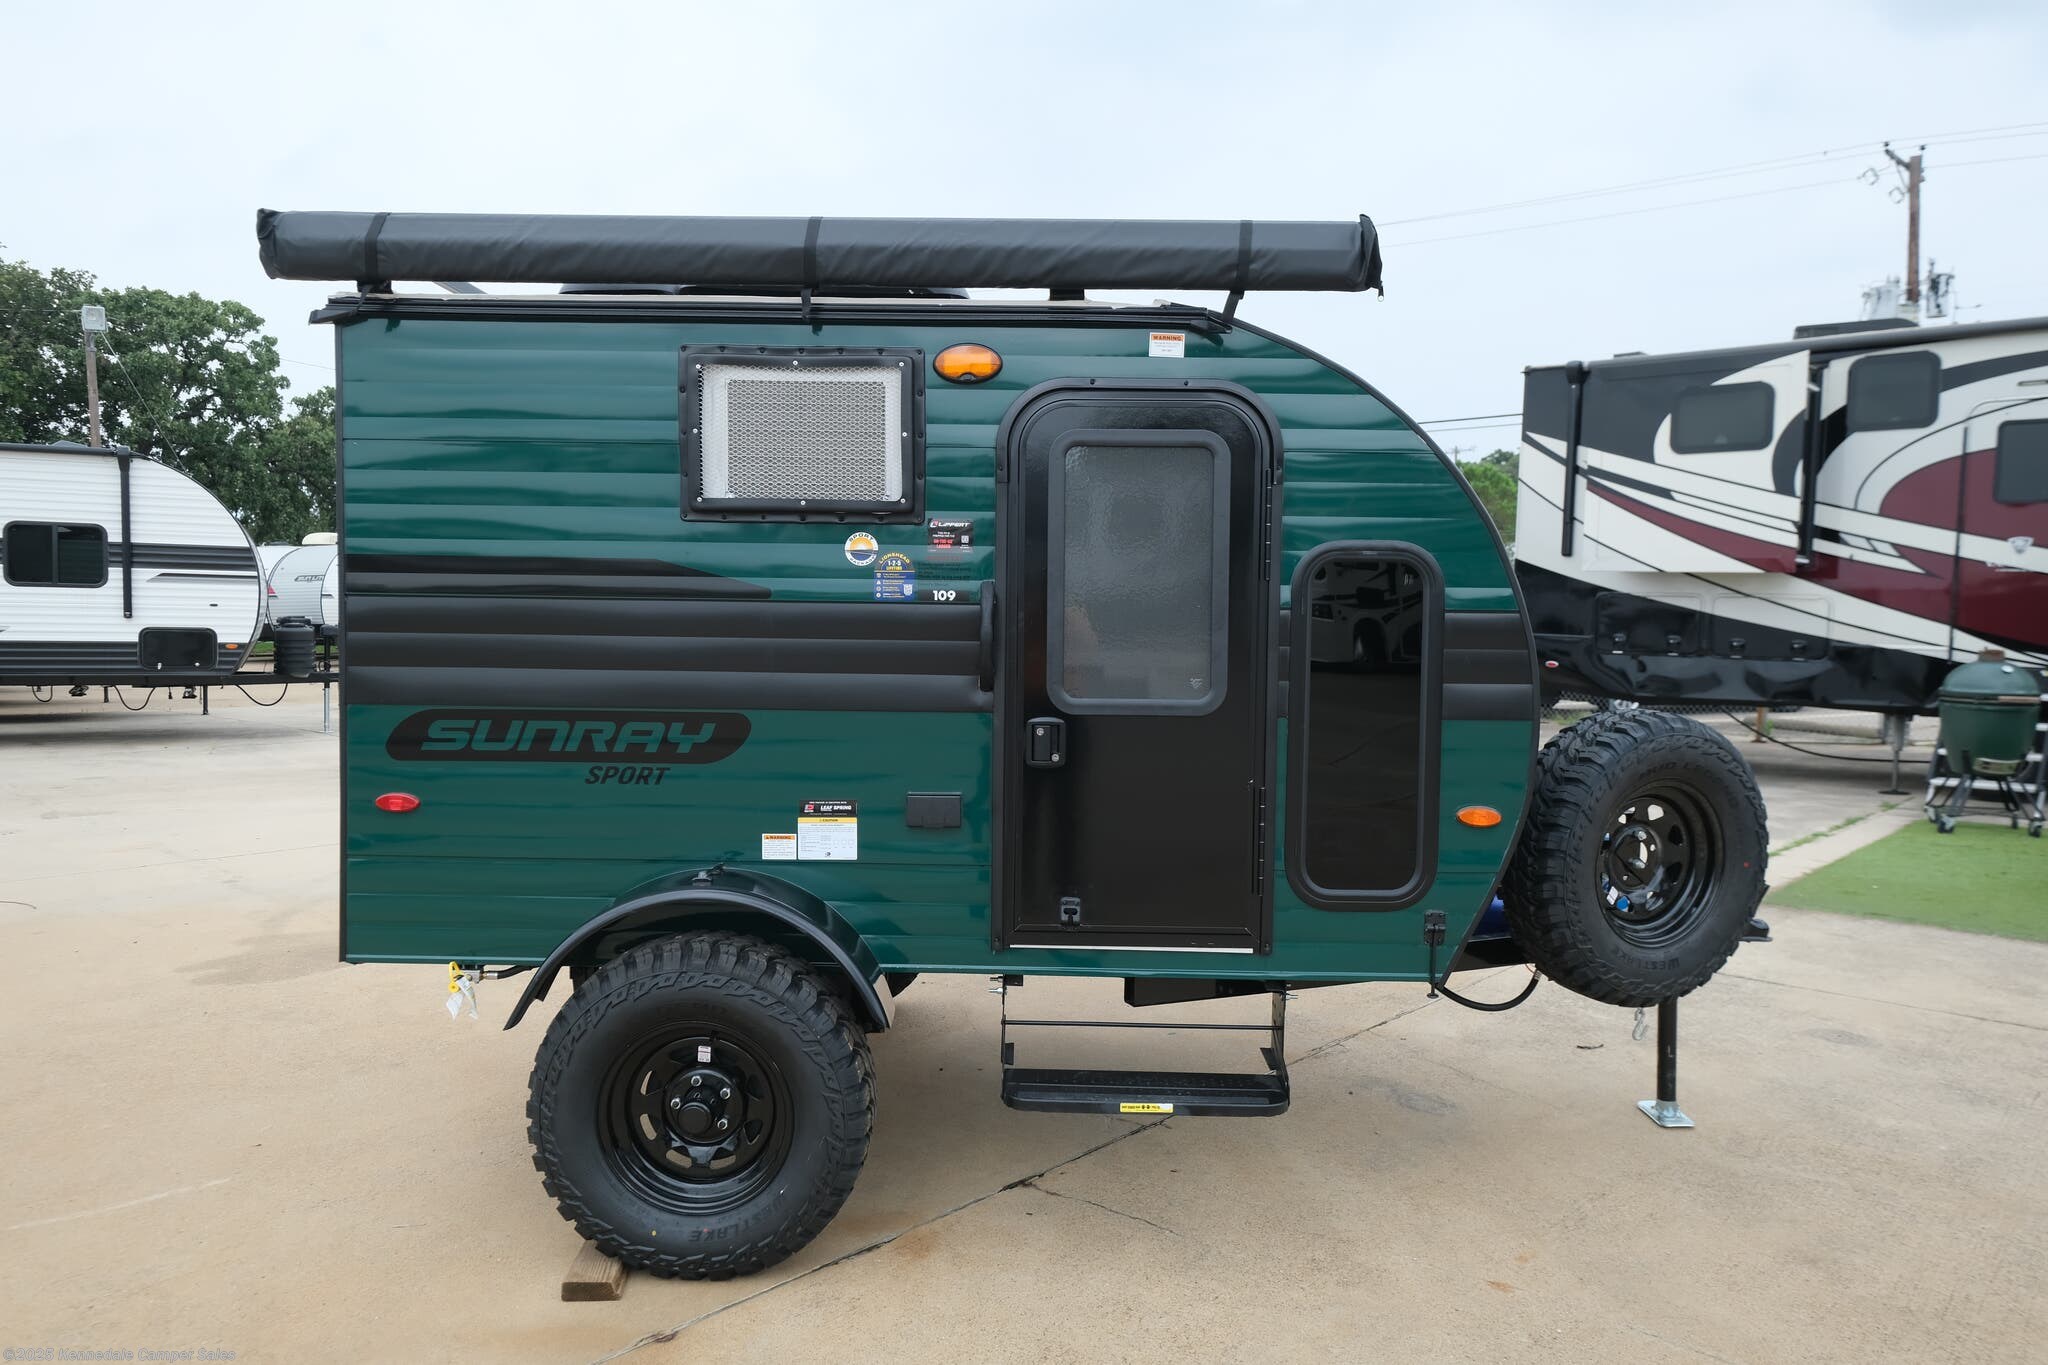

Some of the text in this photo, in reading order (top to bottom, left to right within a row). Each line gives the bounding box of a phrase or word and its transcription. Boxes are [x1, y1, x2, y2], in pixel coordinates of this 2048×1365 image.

[879, 552, 910, 564] LIONSHEAD
[933, 590, 956, 601] 109
[421, 719, 717, 753] SUNRAY
[585, 766, 671, 785] SPORT
